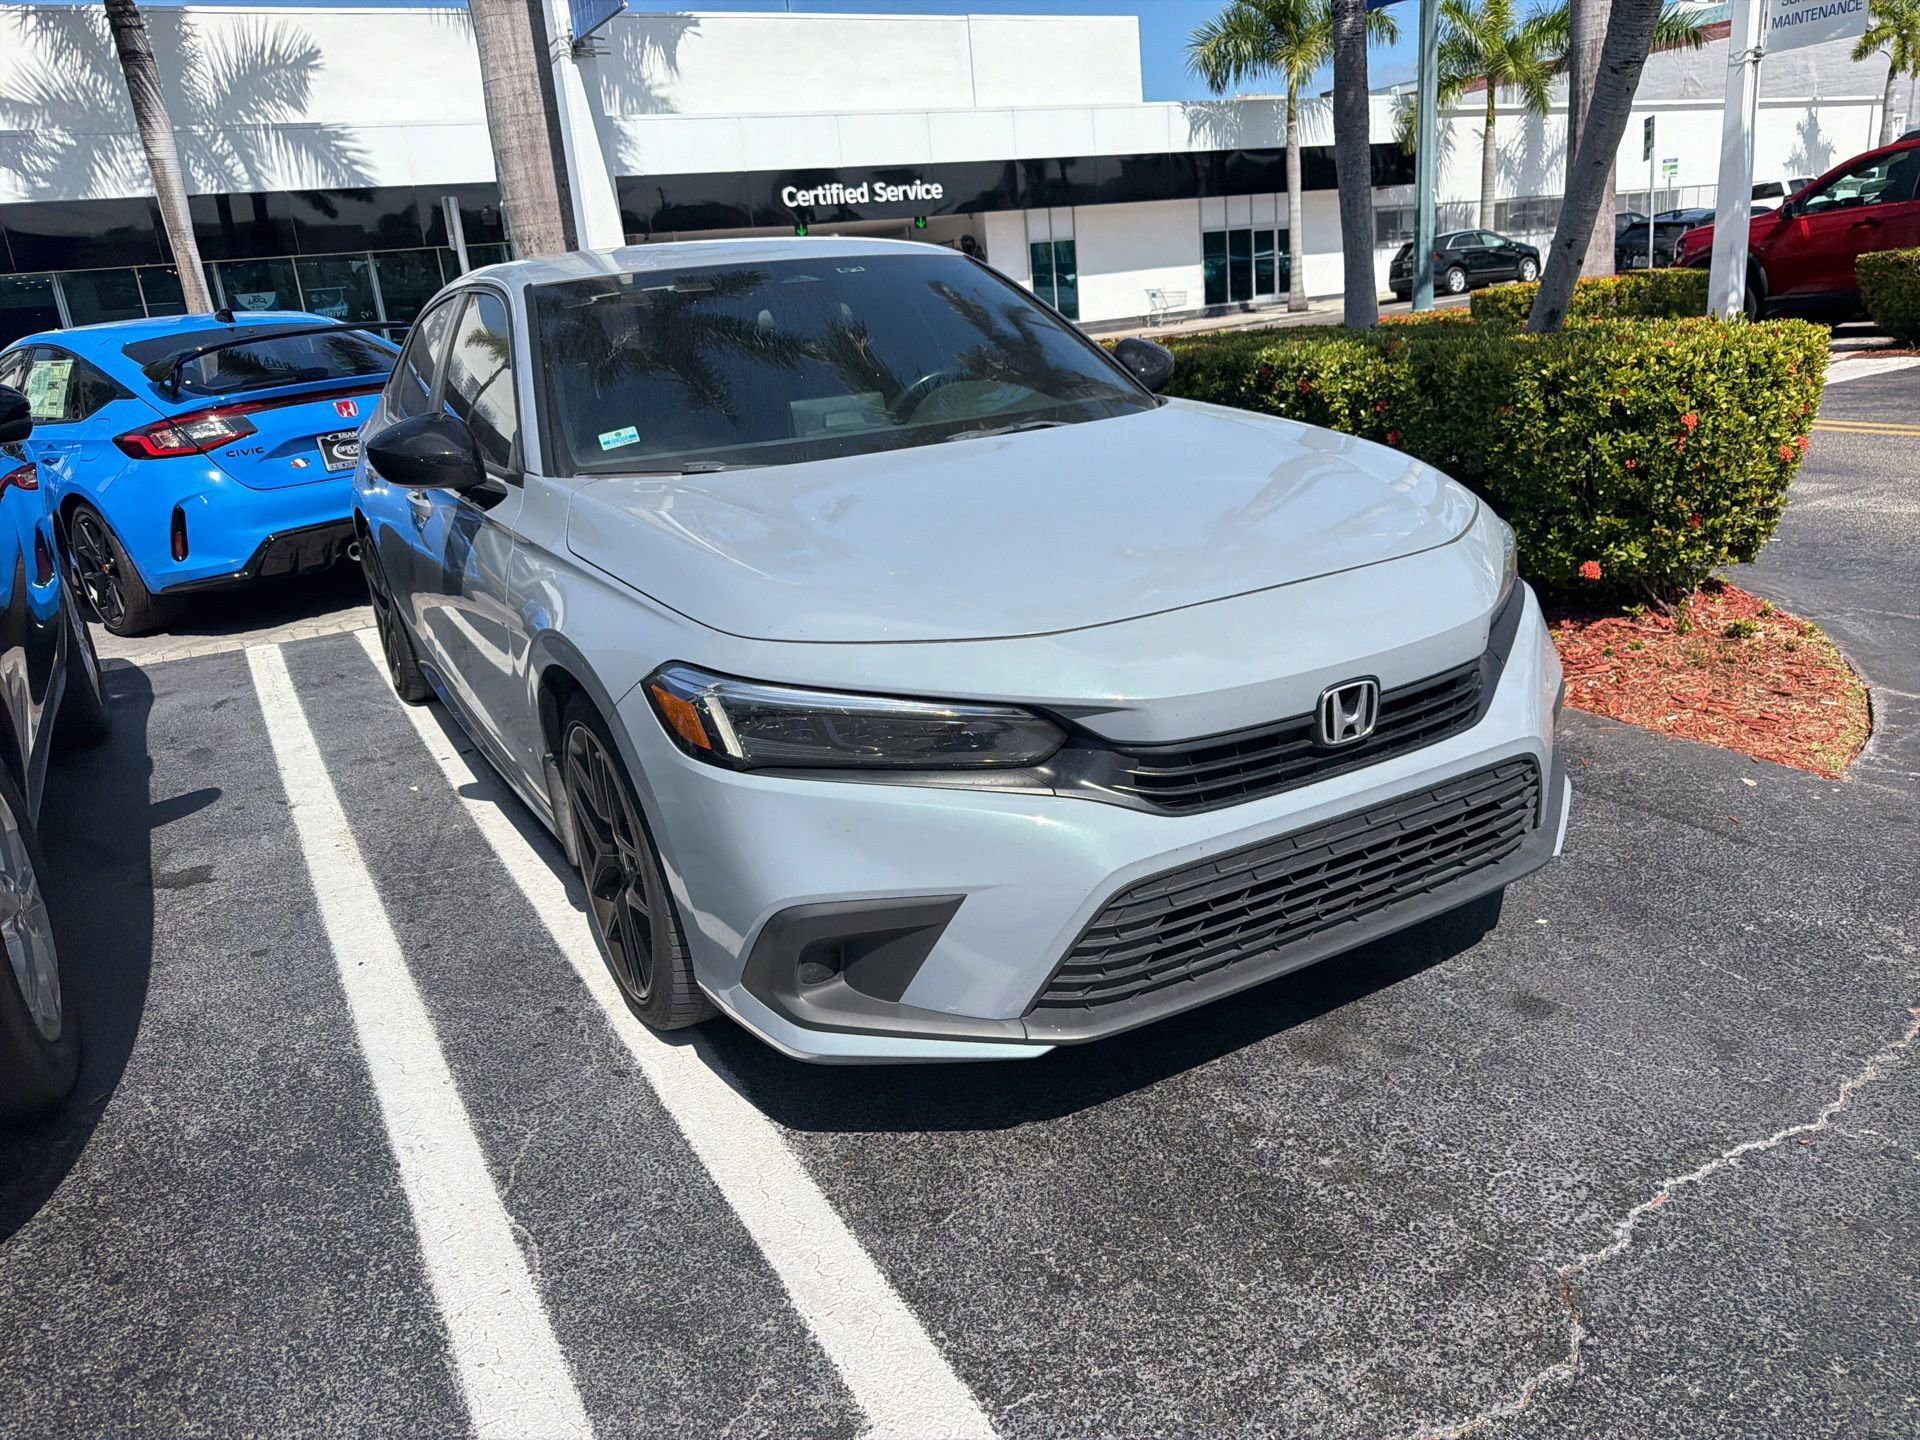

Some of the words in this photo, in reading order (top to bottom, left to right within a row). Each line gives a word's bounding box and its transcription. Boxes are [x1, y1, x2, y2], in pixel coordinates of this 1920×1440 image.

[1772, 0, 1863, 30] MAINTENANCE
[781, 181, 870, 208] Certified
[872, 179, 944, 203] Service
[225, 446, 265, 458] CIVIC
